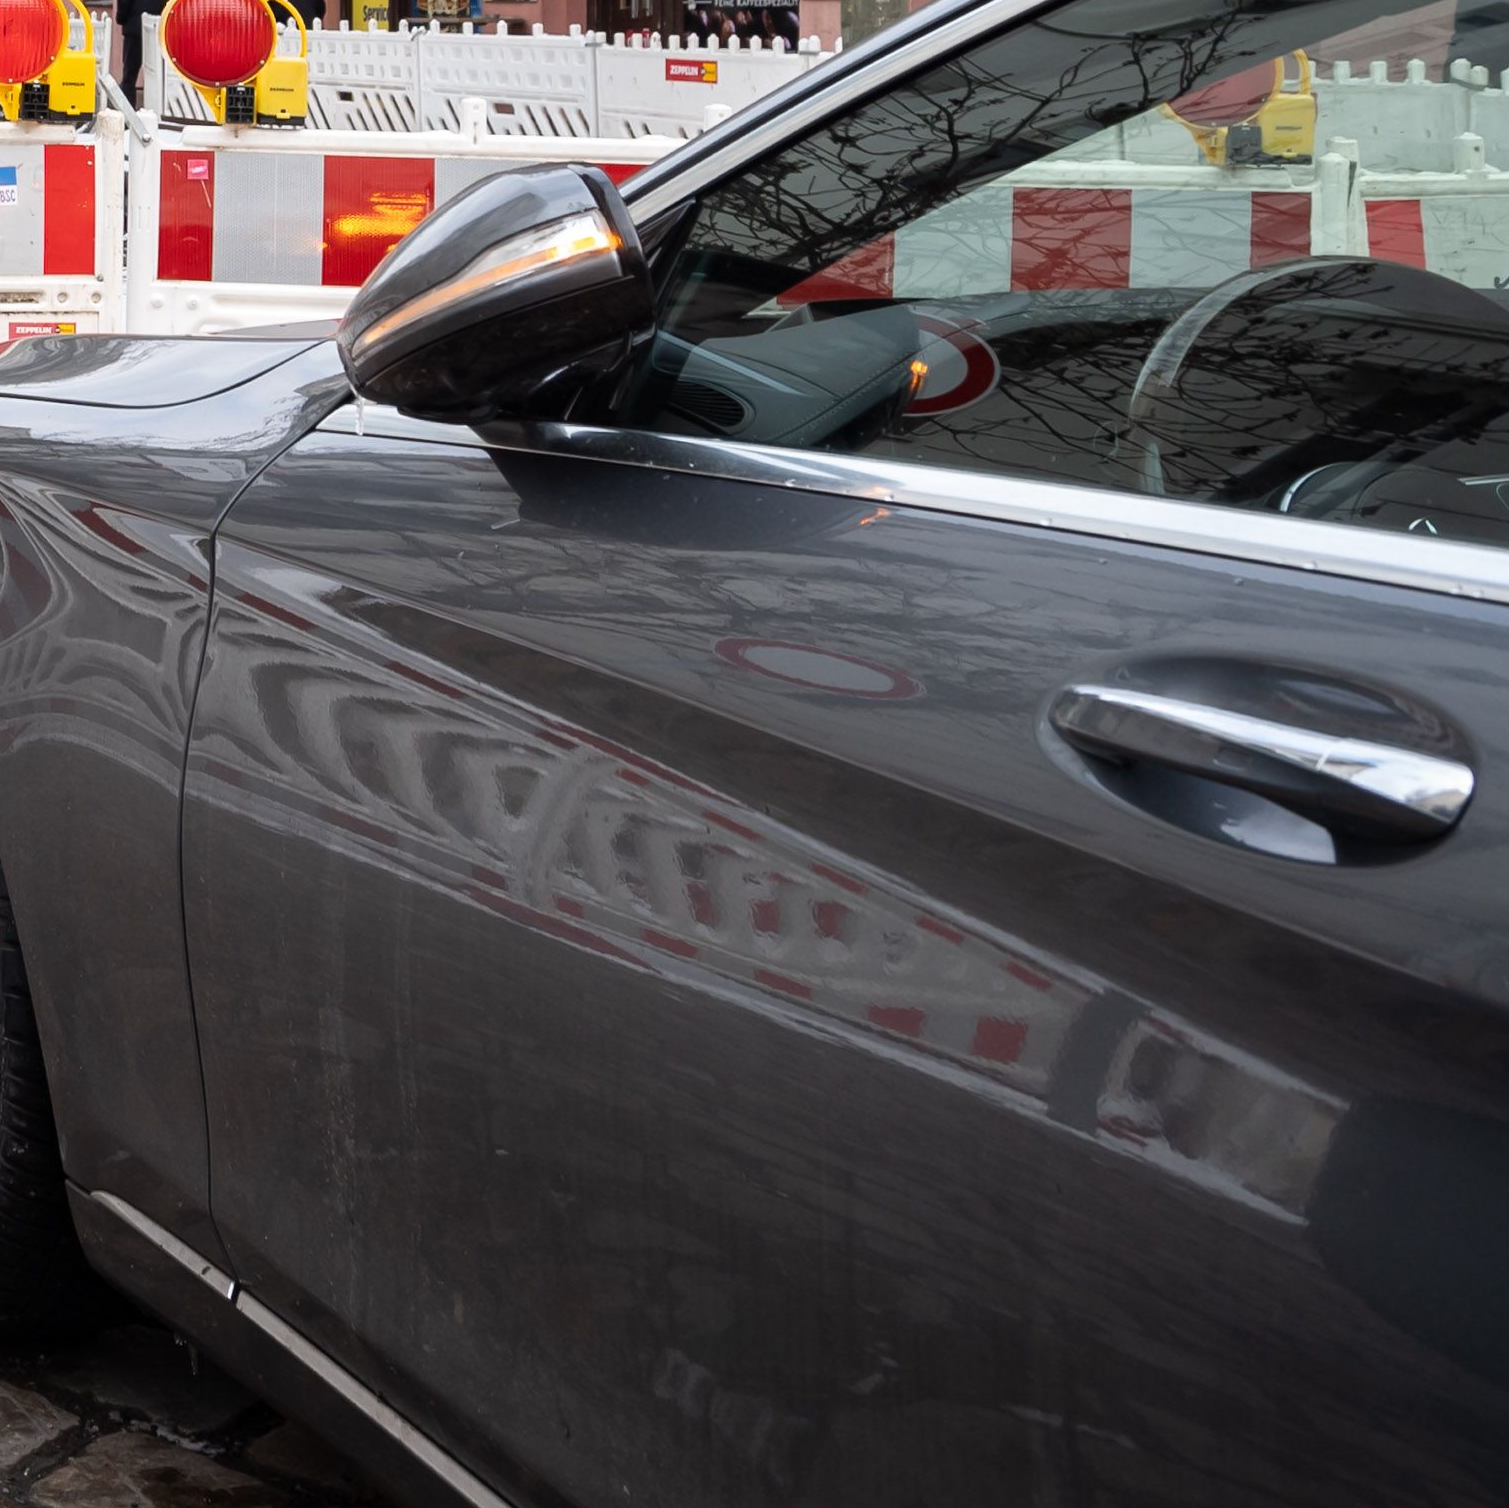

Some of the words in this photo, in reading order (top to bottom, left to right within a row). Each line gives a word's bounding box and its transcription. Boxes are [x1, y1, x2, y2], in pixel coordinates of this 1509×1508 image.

[669, 64, 699, 76] ZEPPELIN
[0, 189, 17, 204] BSC
[15, 325, 53, 335] ZEPPELIN
